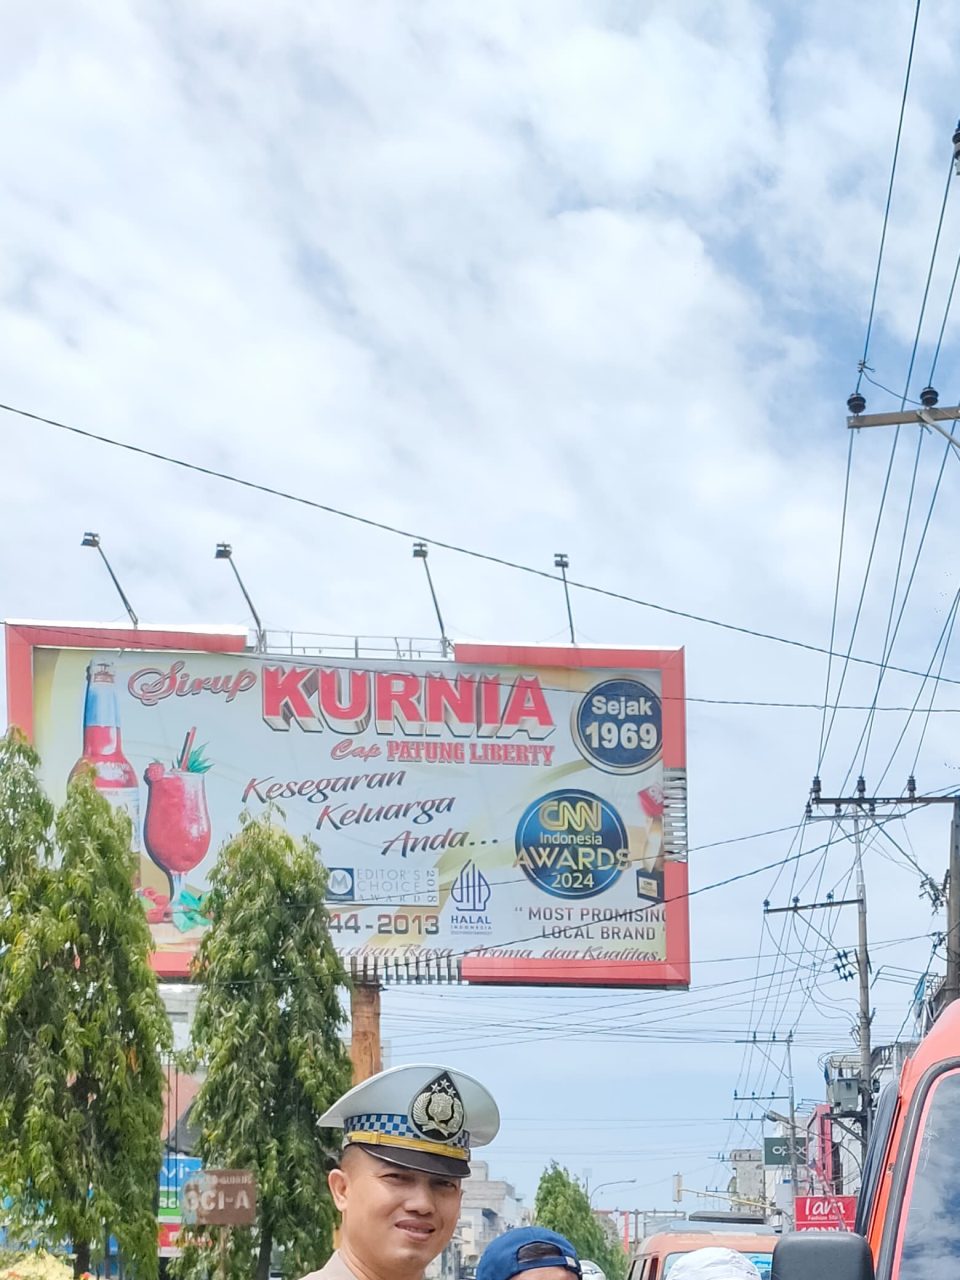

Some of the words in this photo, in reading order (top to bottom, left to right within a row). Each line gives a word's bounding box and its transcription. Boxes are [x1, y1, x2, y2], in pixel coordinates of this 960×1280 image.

[127, 661, 257, 706] Sirup
[261, 665, 557, 740] KURNIA
[591, 695, 653, 719] Sejak
[585, 722, 658, 750] 1969
[331, 738, 381, 762] Cap
[386, 740, 465, 765] PATUNG
[469, 742, 556, 767] LIBERTY
[241, 770, 407, 804] Kesegaran
[316, 796, 456, 831] Keluarga
[538, 800, 603, 831] CNN
[540, 832, 603, 845] Indonesia
[512, 846, 633, 871] AWARDS
[357, 868, 421, 880] EDITOR'S
[357, 880, 421, 892] CHOICE
[551, 872, 595, 888] 2024
[451, 915, 492, 924] HALAL
[528, 907, 574, 921] MOST
[542, 925, 594, 940] LOCAL
[600, 926, 656, 941] BRAND
